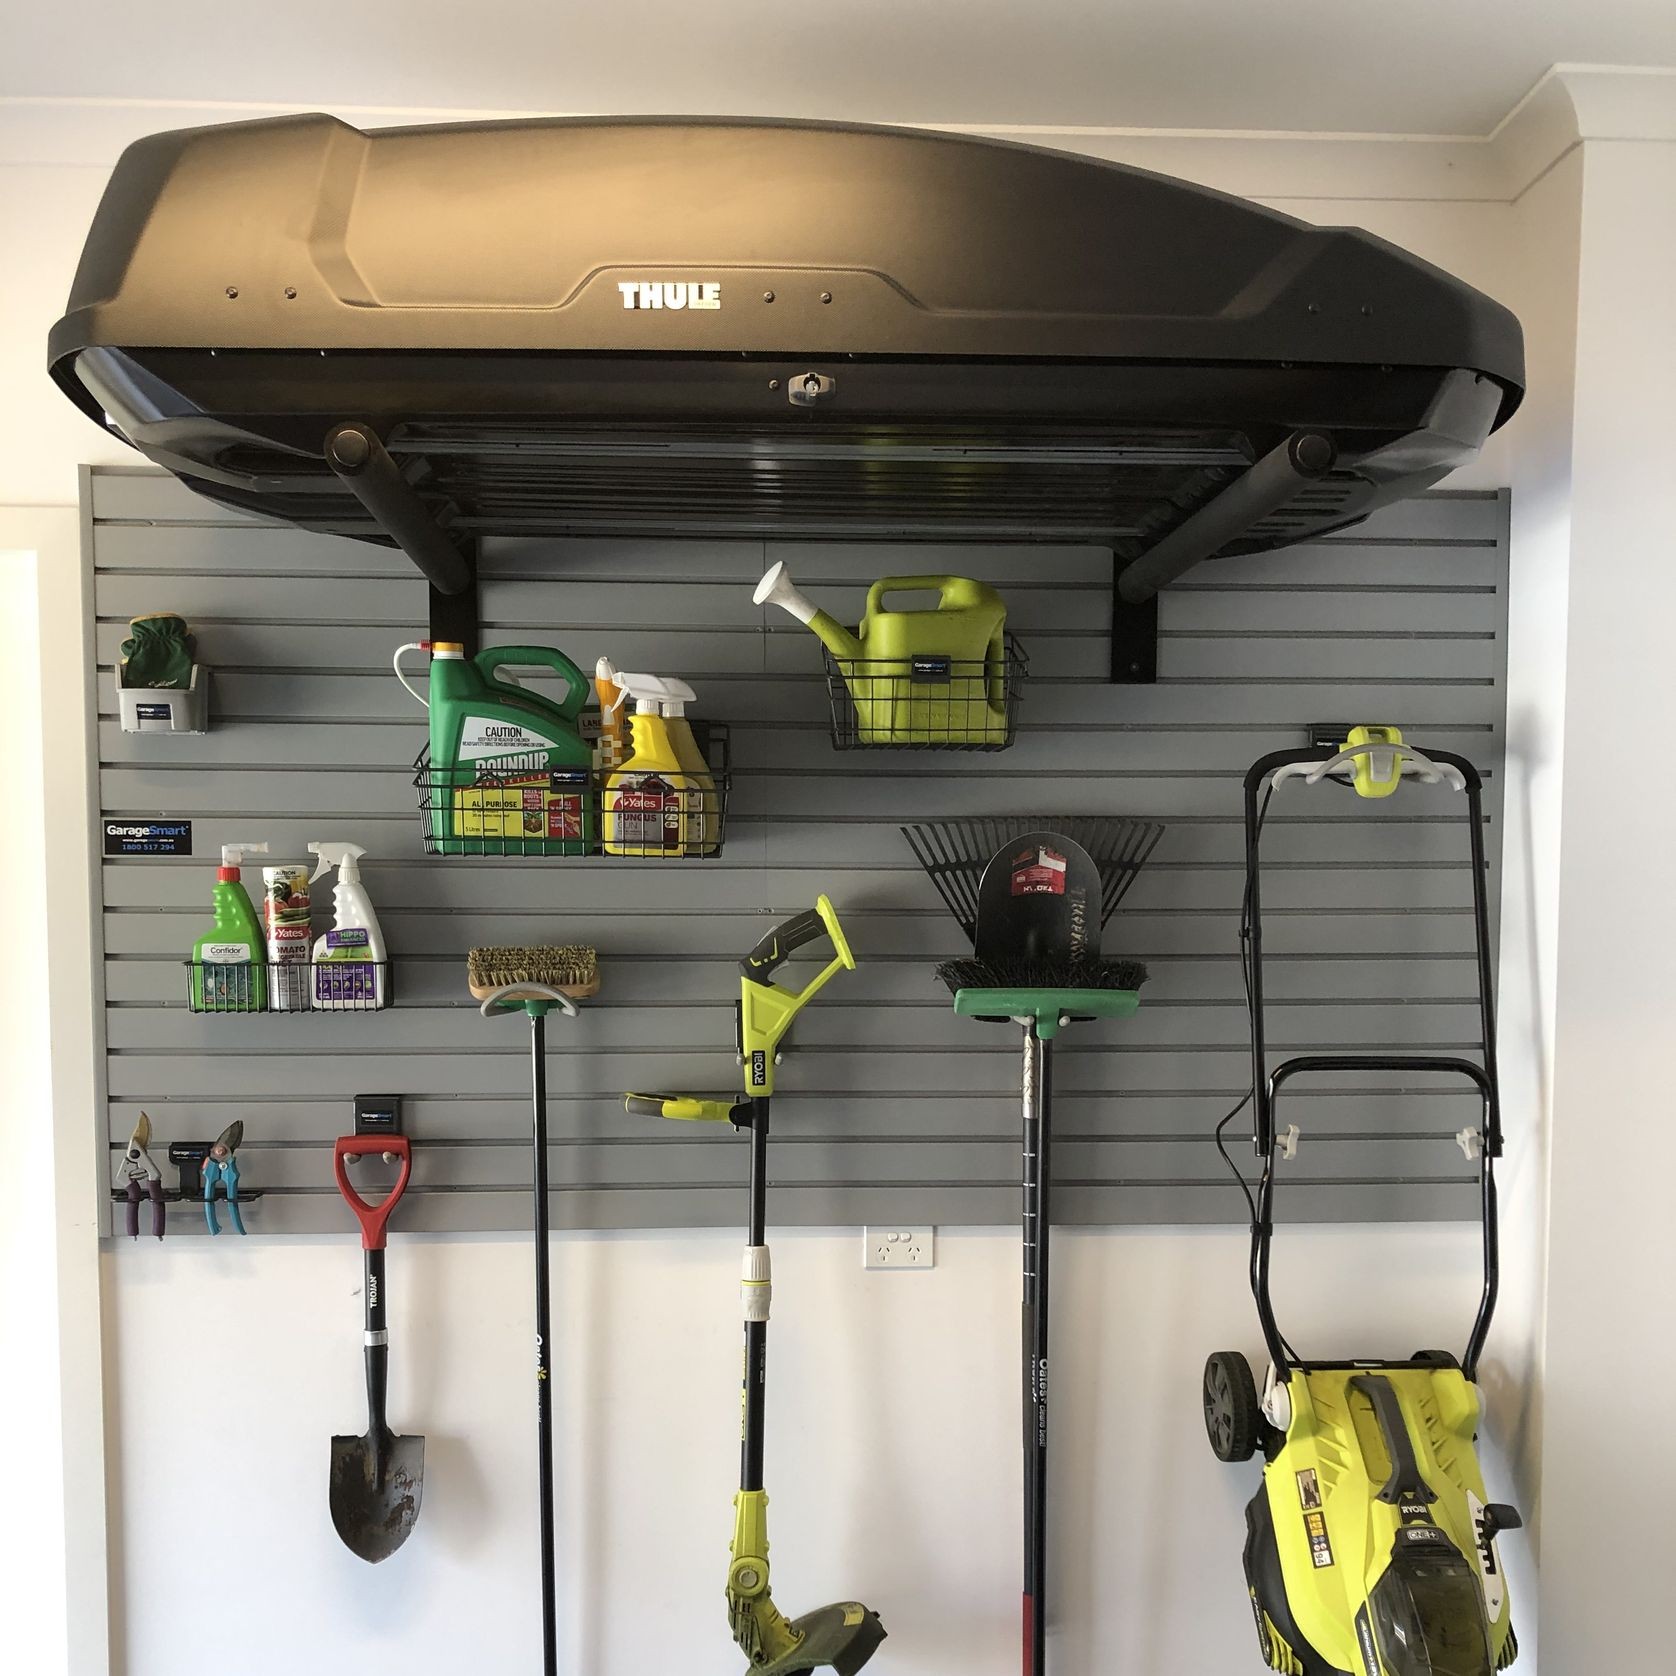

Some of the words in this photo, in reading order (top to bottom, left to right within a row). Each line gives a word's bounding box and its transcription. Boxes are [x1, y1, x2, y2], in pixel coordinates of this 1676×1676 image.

[617, 282, 721, 310] THULE
[485, 727, 522, 737] CAUTION
[629, 798, 656, 809] Yates
[106, 825, 186, 837] GarageSmart
[278, 929, 304, 938] Yates
[341, 930, 366, 938] HIPPO
[754, 1052, 763, 1085] RYOBI
[1401, 1506, 1428, 1514] RYOBI
